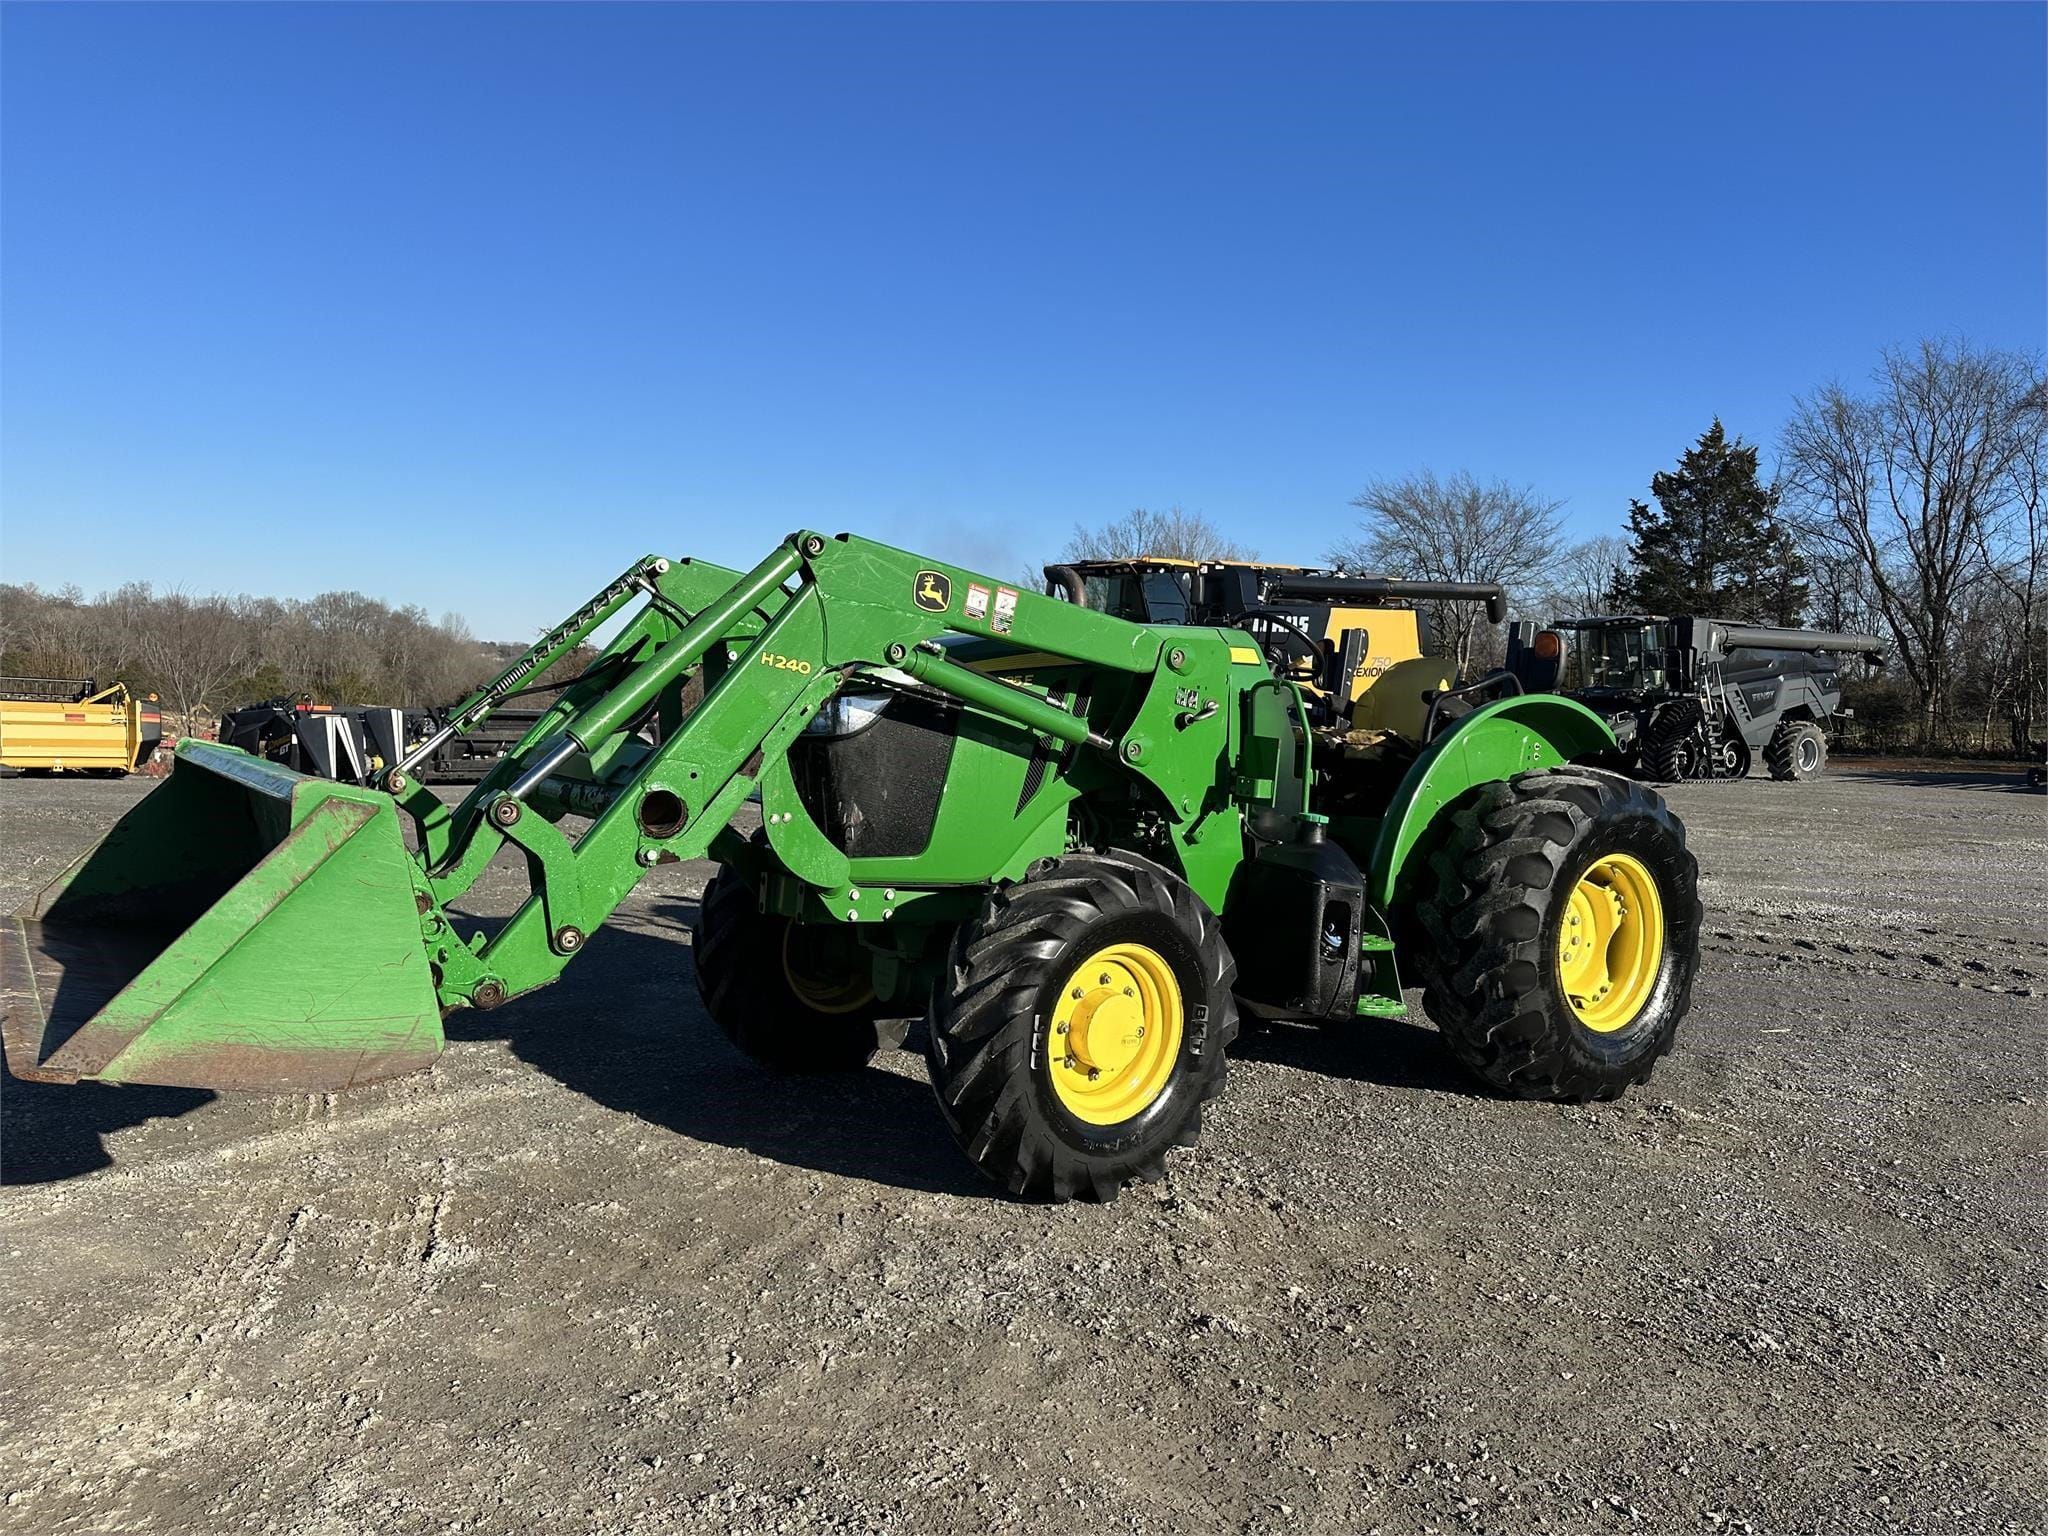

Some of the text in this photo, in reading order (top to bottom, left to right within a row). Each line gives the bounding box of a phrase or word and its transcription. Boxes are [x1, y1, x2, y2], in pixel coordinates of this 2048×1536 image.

[761, 651, 811, 675] H240
[1371, 656, 1392, 667] 750
[1353, 667, 1386, 677] EXION
[1189, 1002, 1209, 1056] BKT
